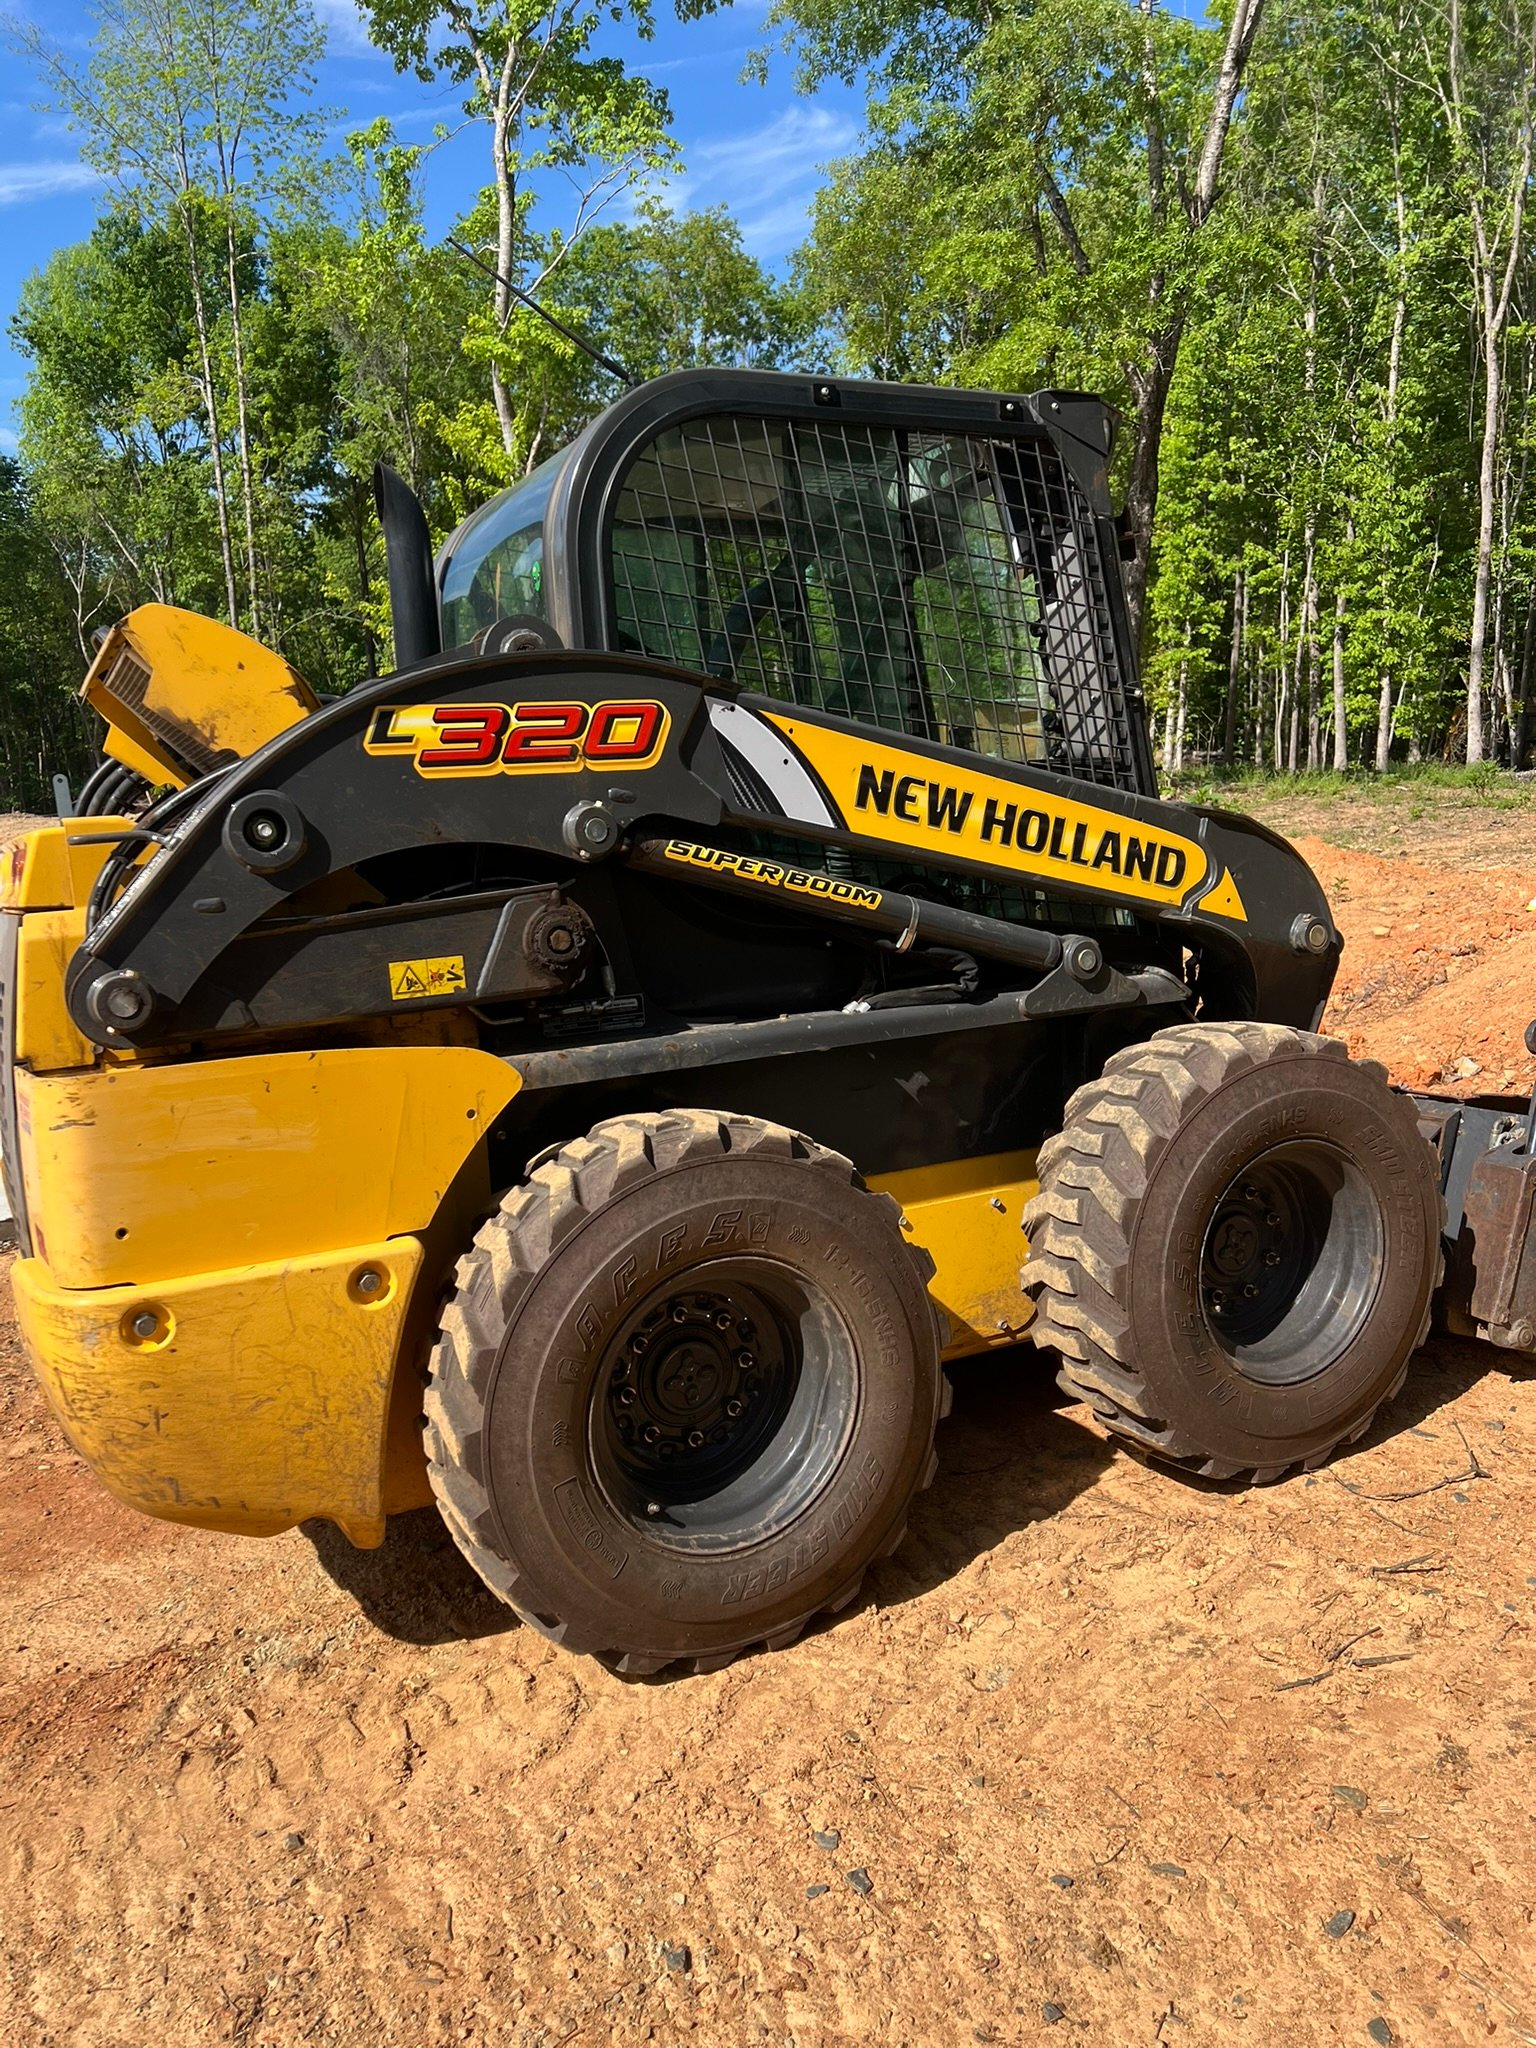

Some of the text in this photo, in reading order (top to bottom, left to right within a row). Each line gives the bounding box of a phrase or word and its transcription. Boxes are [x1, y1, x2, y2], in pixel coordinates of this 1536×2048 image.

[365, 701, 668, 774] L320
[854, 762, 1187, 889] NEW HOLLAND
[665, 839, 883, 910] SUPER BOOM
[831, 1450, 885, 1541] SKID
[720, 1519, 830, 1605] STEER
